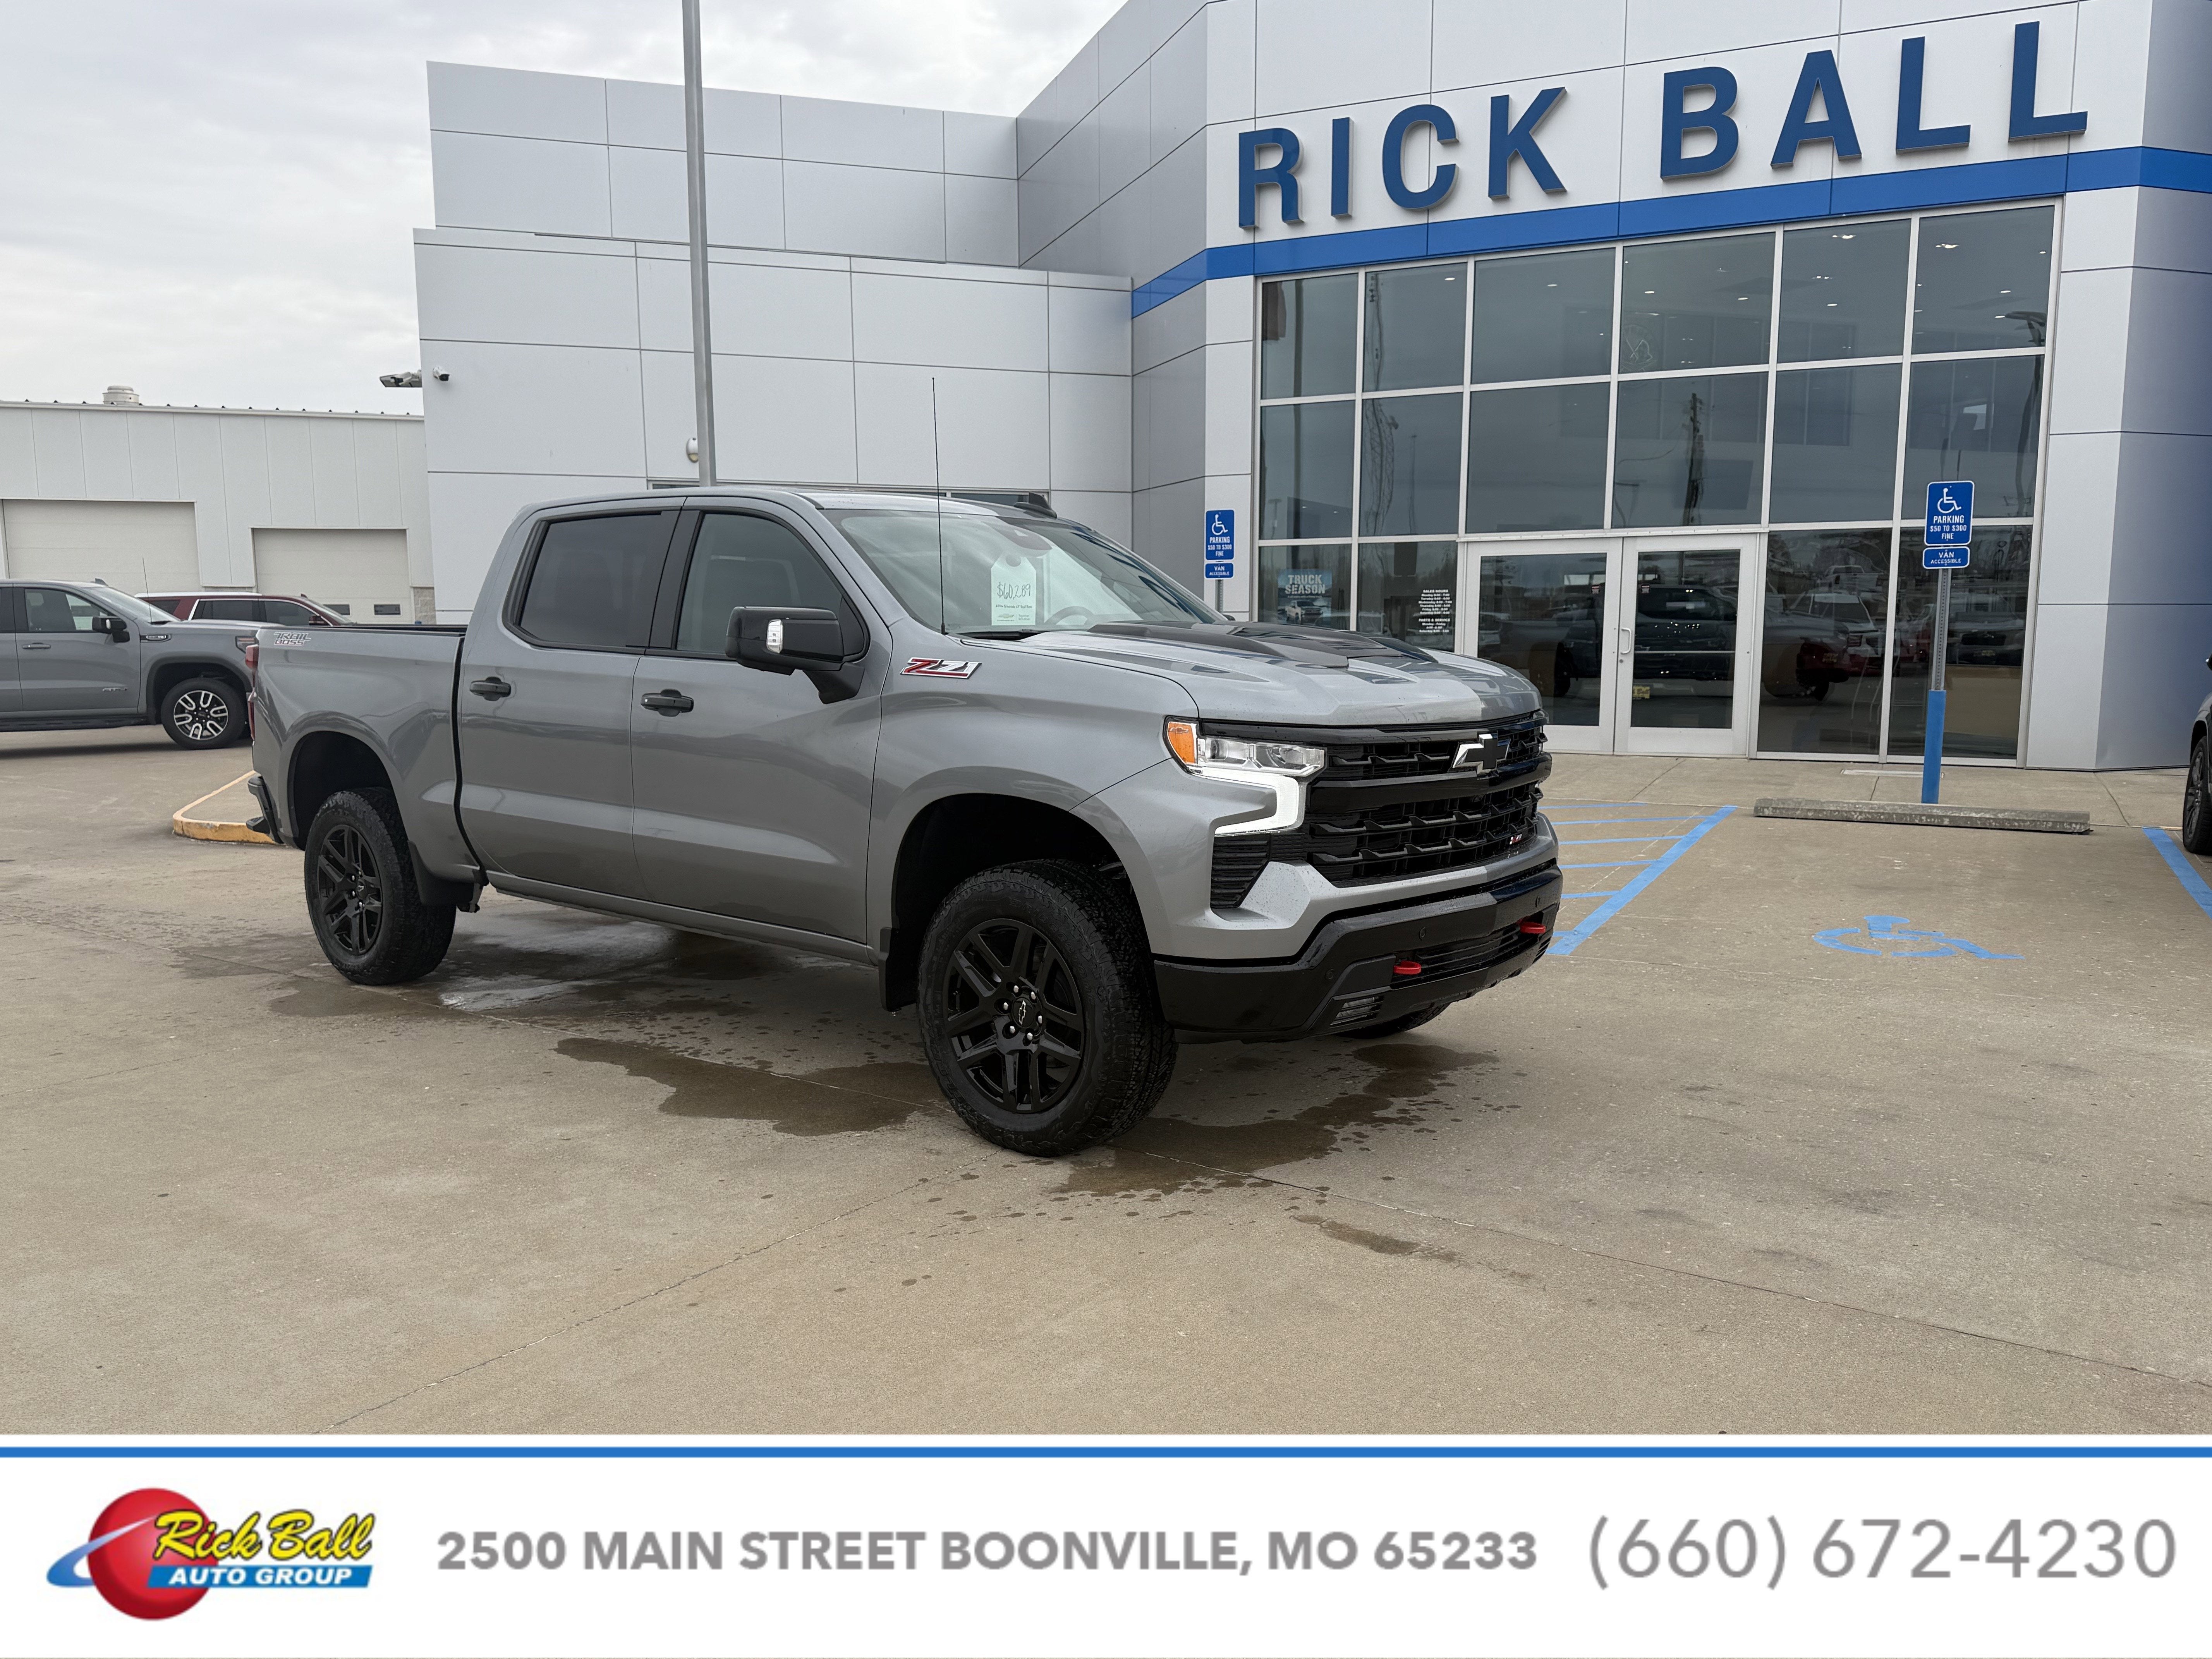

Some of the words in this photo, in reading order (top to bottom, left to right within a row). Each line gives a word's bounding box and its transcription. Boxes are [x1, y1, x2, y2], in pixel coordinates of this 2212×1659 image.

[1238, 86, 1567, 230] RICK
[1659, 21, 2088, 180] BALL
[1933, 515, 1965, 524] PARKING
[1288, 575, 1322, 584] TRUCK
[997, 582, 1031, 600] $60,289
[1285, 584, 1326, 594] SEASON
[273, 632, 311, 641] TRAIL
[900, 657, 982, 679] Z71
